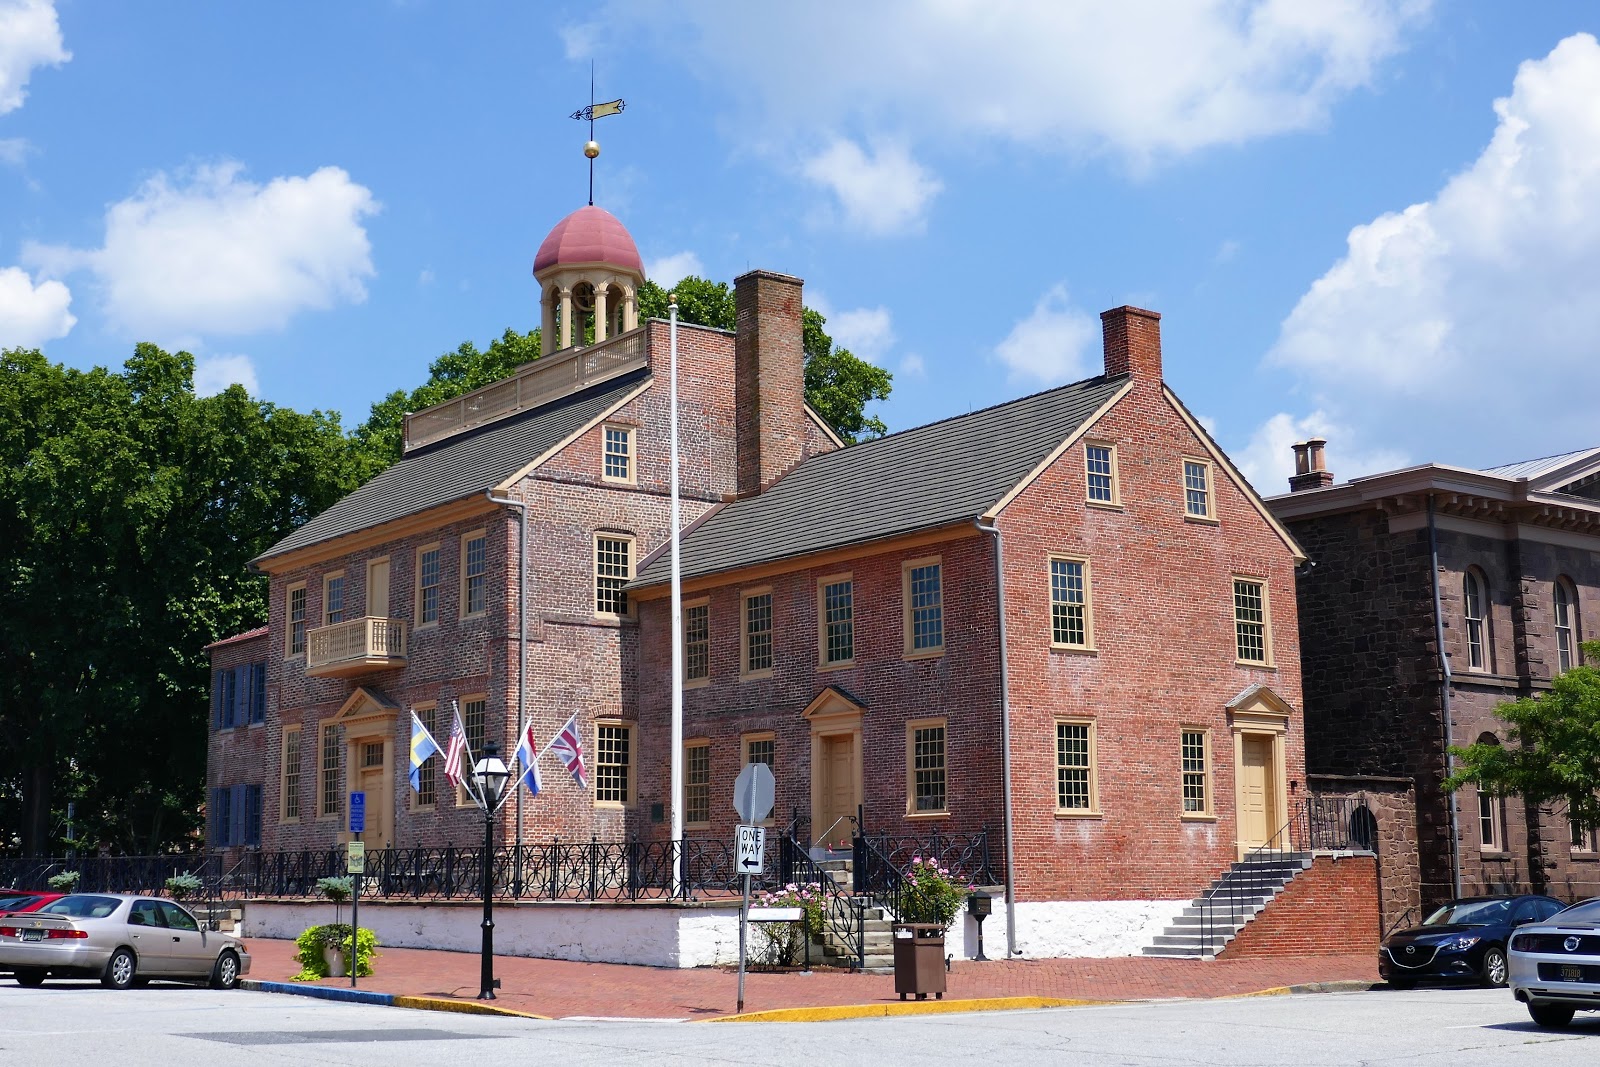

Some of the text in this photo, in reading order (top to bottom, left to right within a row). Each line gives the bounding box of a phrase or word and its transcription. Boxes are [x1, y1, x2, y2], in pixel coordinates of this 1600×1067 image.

[742, 830, 762, 842] ONE
[741, 843, 762, 855] WAY
[1560, 968, 1581, 978] 371818
